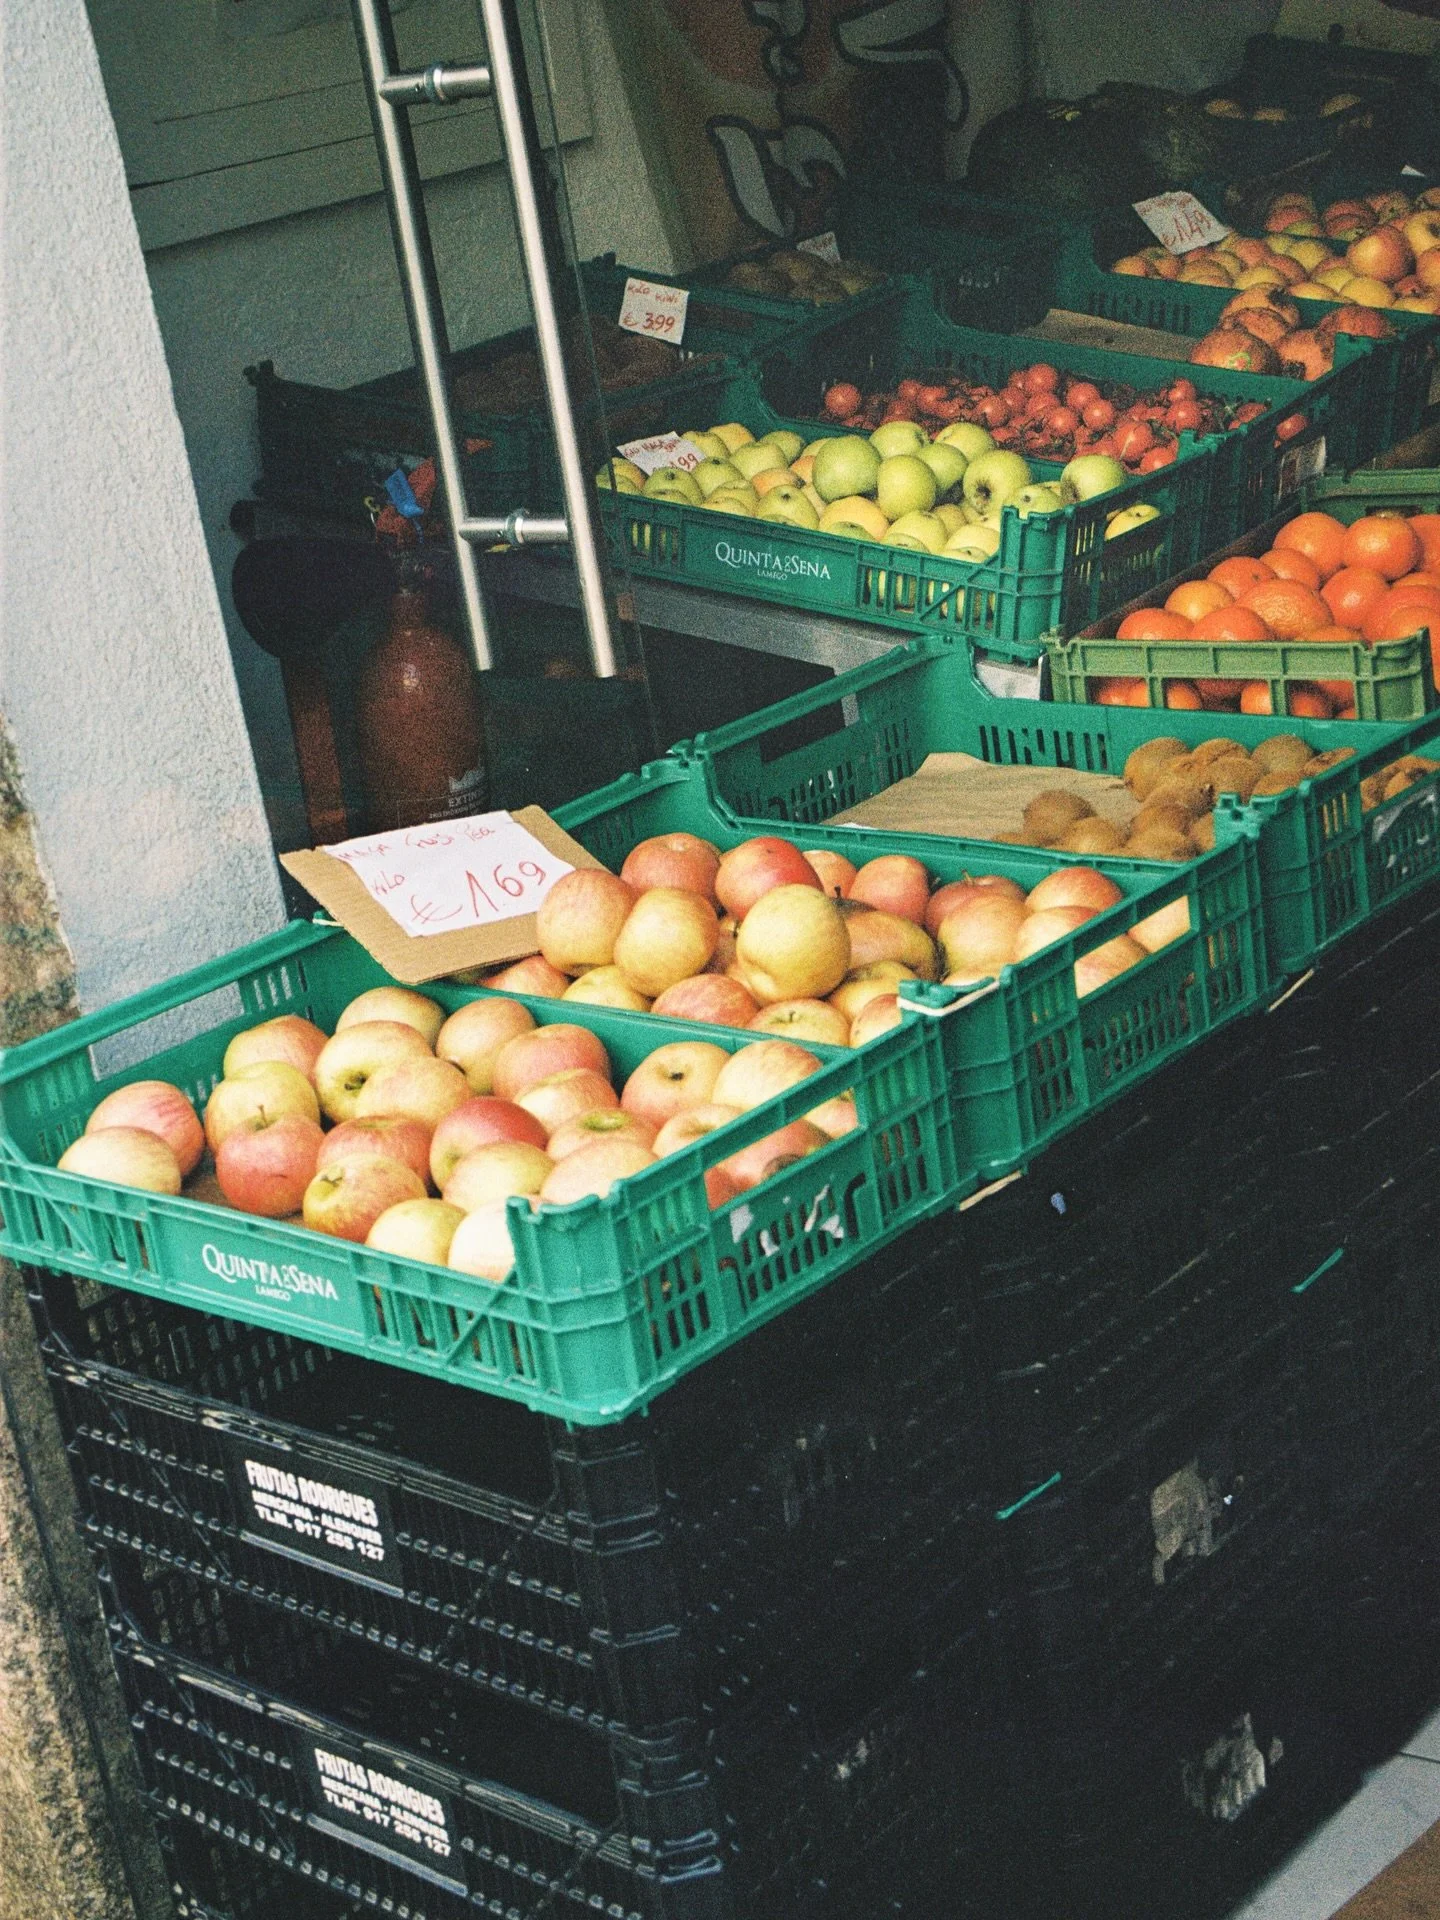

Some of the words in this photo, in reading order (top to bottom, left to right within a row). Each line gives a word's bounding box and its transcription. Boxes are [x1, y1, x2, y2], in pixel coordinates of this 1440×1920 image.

[715, 541, 783, 571] QUINTA
[790, 555, 831, 580] SENA
[202, 1243, 283, 1287] QUINTA
[288, 1264, 339, 1301] SENA
[245, 1459, 299, 1501] FRUTAS
[297, 1476, 379, 1528] RODRIGUES
[314, 1747, 369, 1790] FRUTAS
[366, 1768, 446, 1827] RODRIGUES
